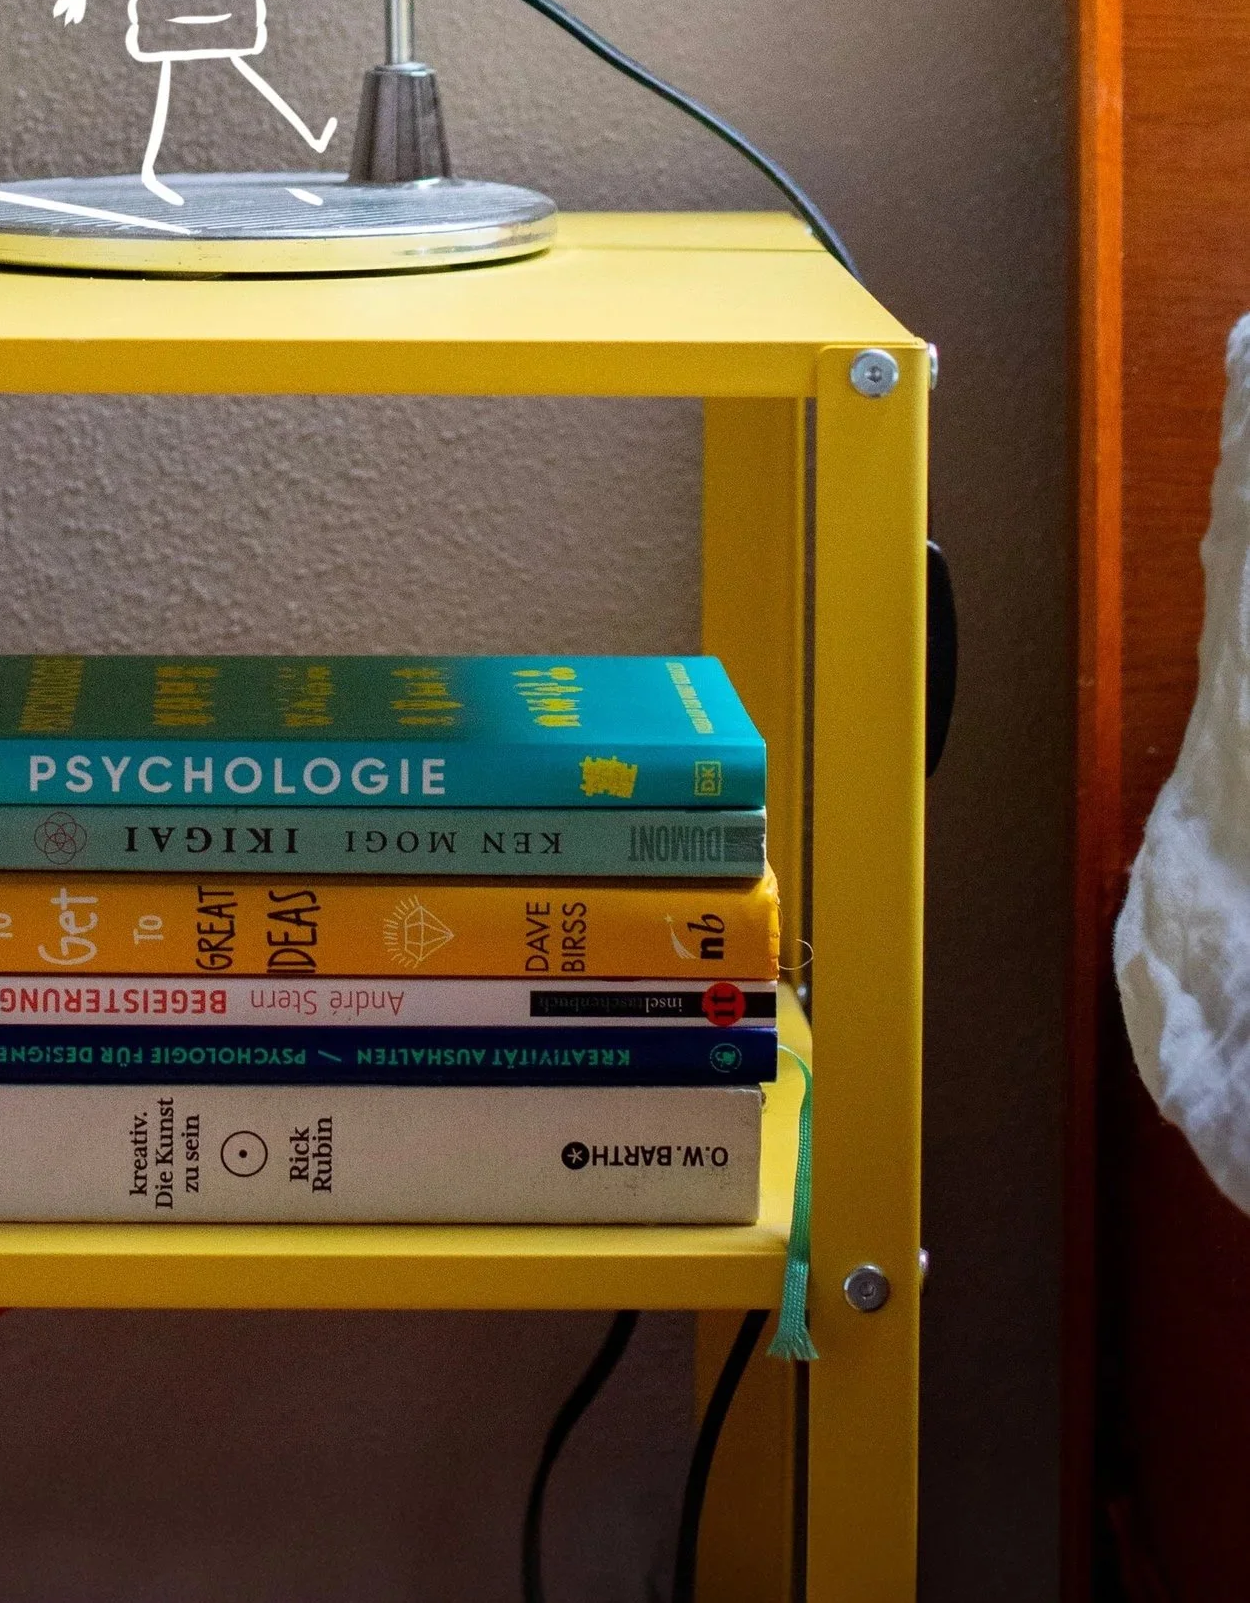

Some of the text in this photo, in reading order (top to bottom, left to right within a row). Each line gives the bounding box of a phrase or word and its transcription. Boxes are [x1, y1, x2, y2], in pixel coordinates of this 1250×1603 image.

[28, 755, 446, 795] PSYCHOLOGIE
[126, 827, 299, 854] IKIGAI
[345, 831, 563, 854] KEN MOGI
[628, 825, 725, 863] DUMONT
[38, 888, 99, 966] Get
[195, 885, 238, 972] GREAT
[266, 890, 322, 974] IDEAS
[525, 901, 550, 973] DAVE
[561, 901, 587, 973] BIRSS
[0, 987, 228, 1014] BEGEISTERUNG
[250, 989, 405, 1014] André Stern
[101, 1047, 143, 1068] FÜR
[151, 1046, 307, 1065] PSYCHOLOGIE
[357, 1048, 486, 1064] AUSHALTEN
[492, 1048, 630, 1068] KREATIVITÄT
[128, 1110, 149, 1197] kreativ.
[155, 1097, 174, 1210] Die Kunst
[181, 1114, 200, 1194] zu sein
[288, 1125, 310, 1182] Rick
[312, 1115, 333, 1193] Rubin
